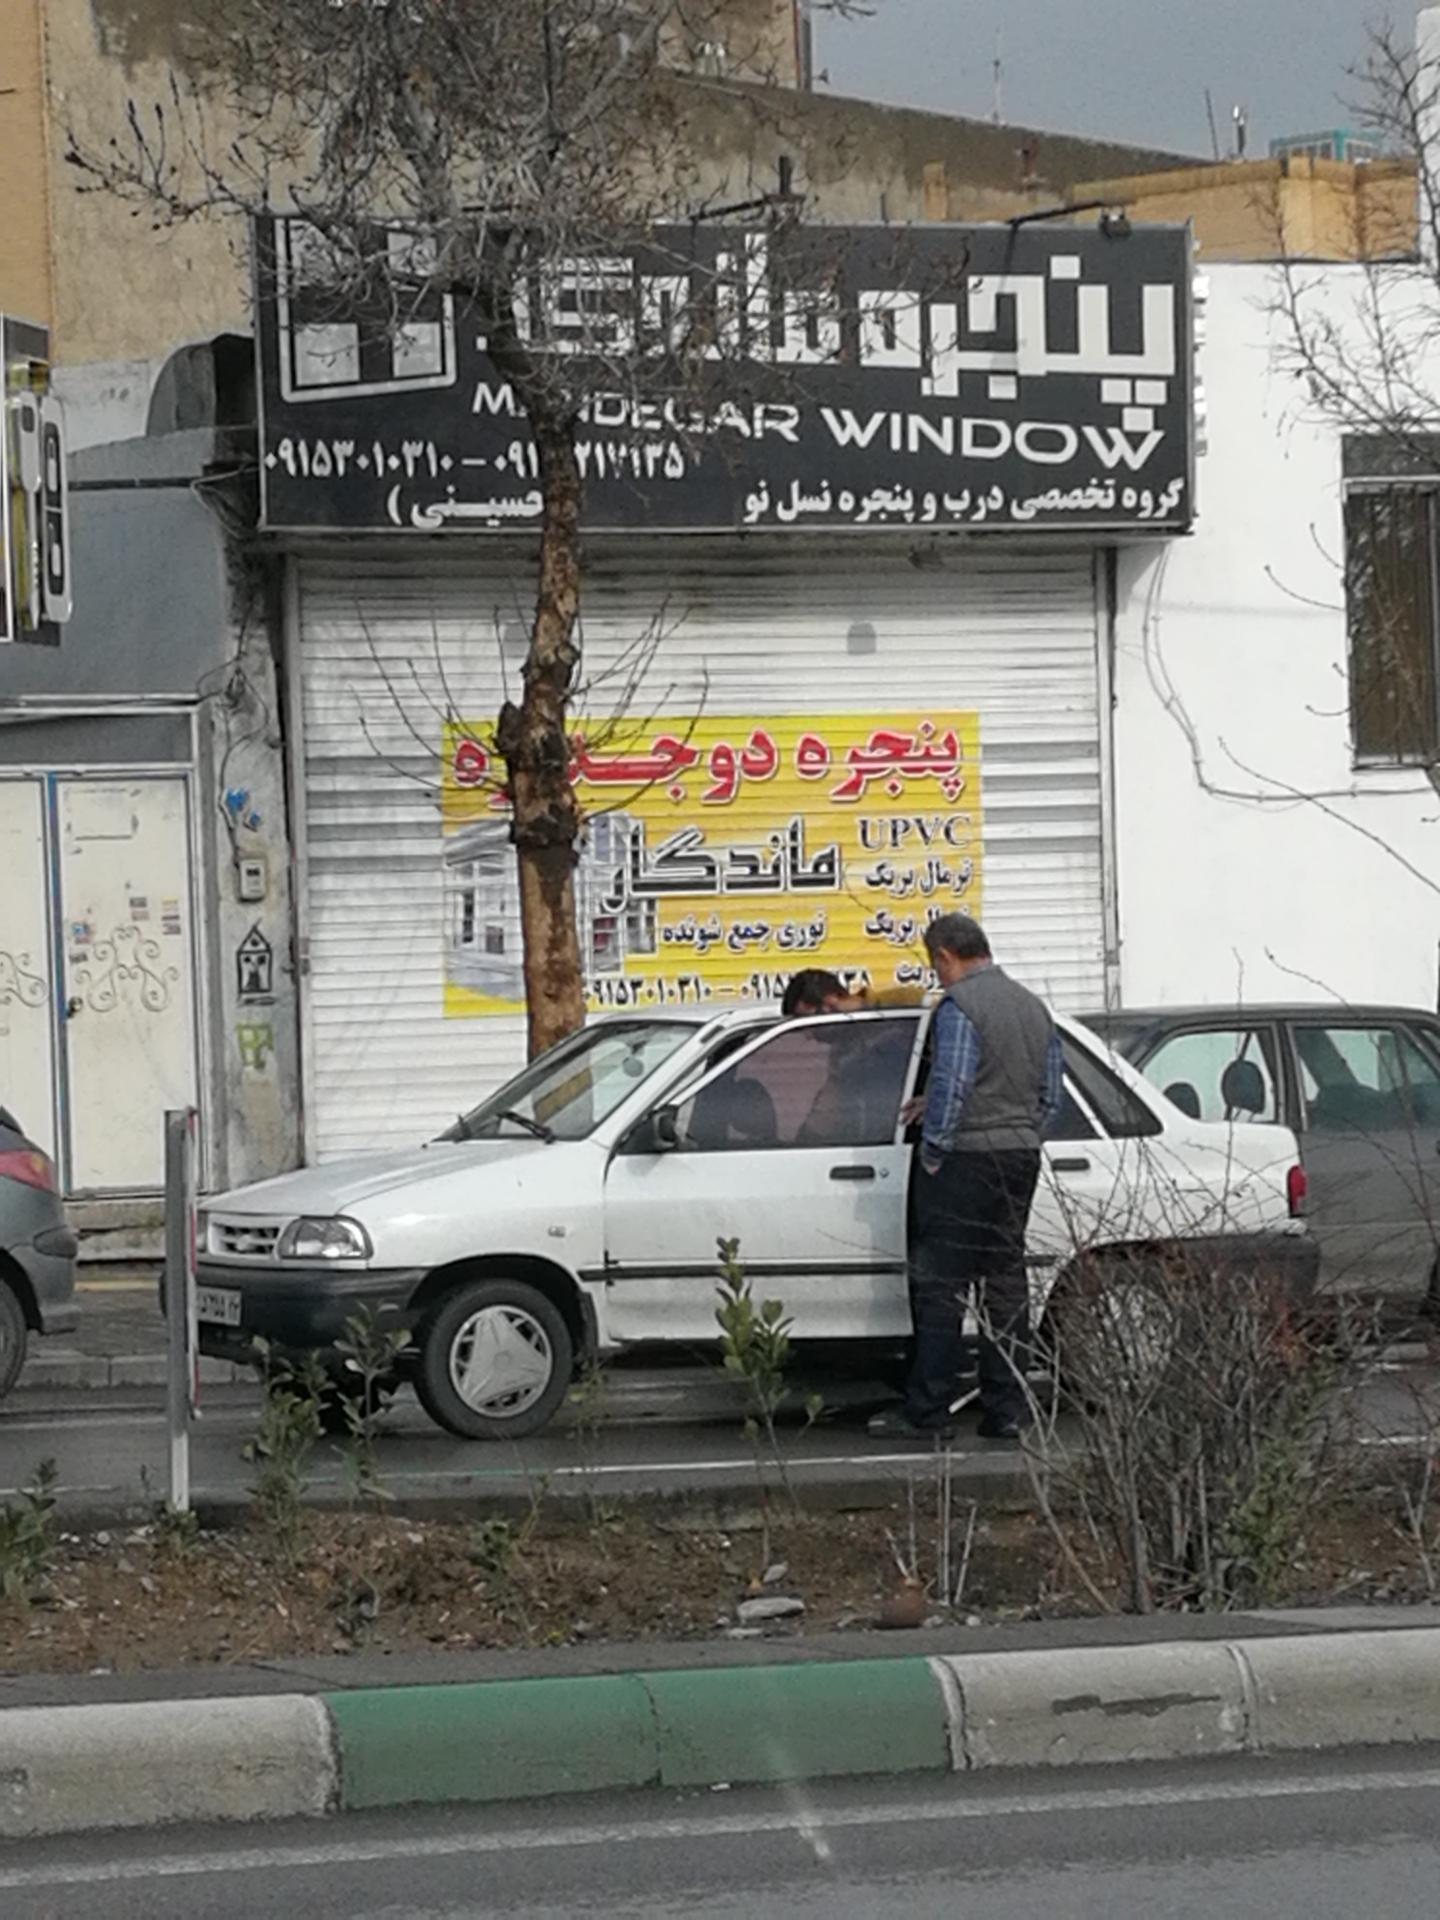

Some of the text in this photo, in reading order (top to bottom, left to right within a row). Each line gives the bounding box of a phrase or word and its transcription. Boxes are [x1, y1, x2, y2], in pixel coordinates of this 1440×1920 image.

[859, 255, 1176, 432] پنجره
[472, 382, 1165, 470] MDEGAR WINDOW
[264, 439, 453, 478] ۰۹۱۵۳۰۱۰۳۱۰
[743, 479, 770, 523] نو
[776, 479, 832, 522] نسل
[838, 483, 915, 523] پنجره
[919, 491, 937, 522] و
[942, 484, 1004, 521] درب
[1009, 477, 1116, 520] تخصصی
[1121, 477, 1185, 518] گروه
[702, 729, 778, 804] دو
[797, 720, 963, 802] پنجره
[860, 815, 971, 851] UPVC
[603, 815, 840, 911] ماندگار
[662, 914, 722, 952] شونده
[727, 918, 770, 951] جمع
